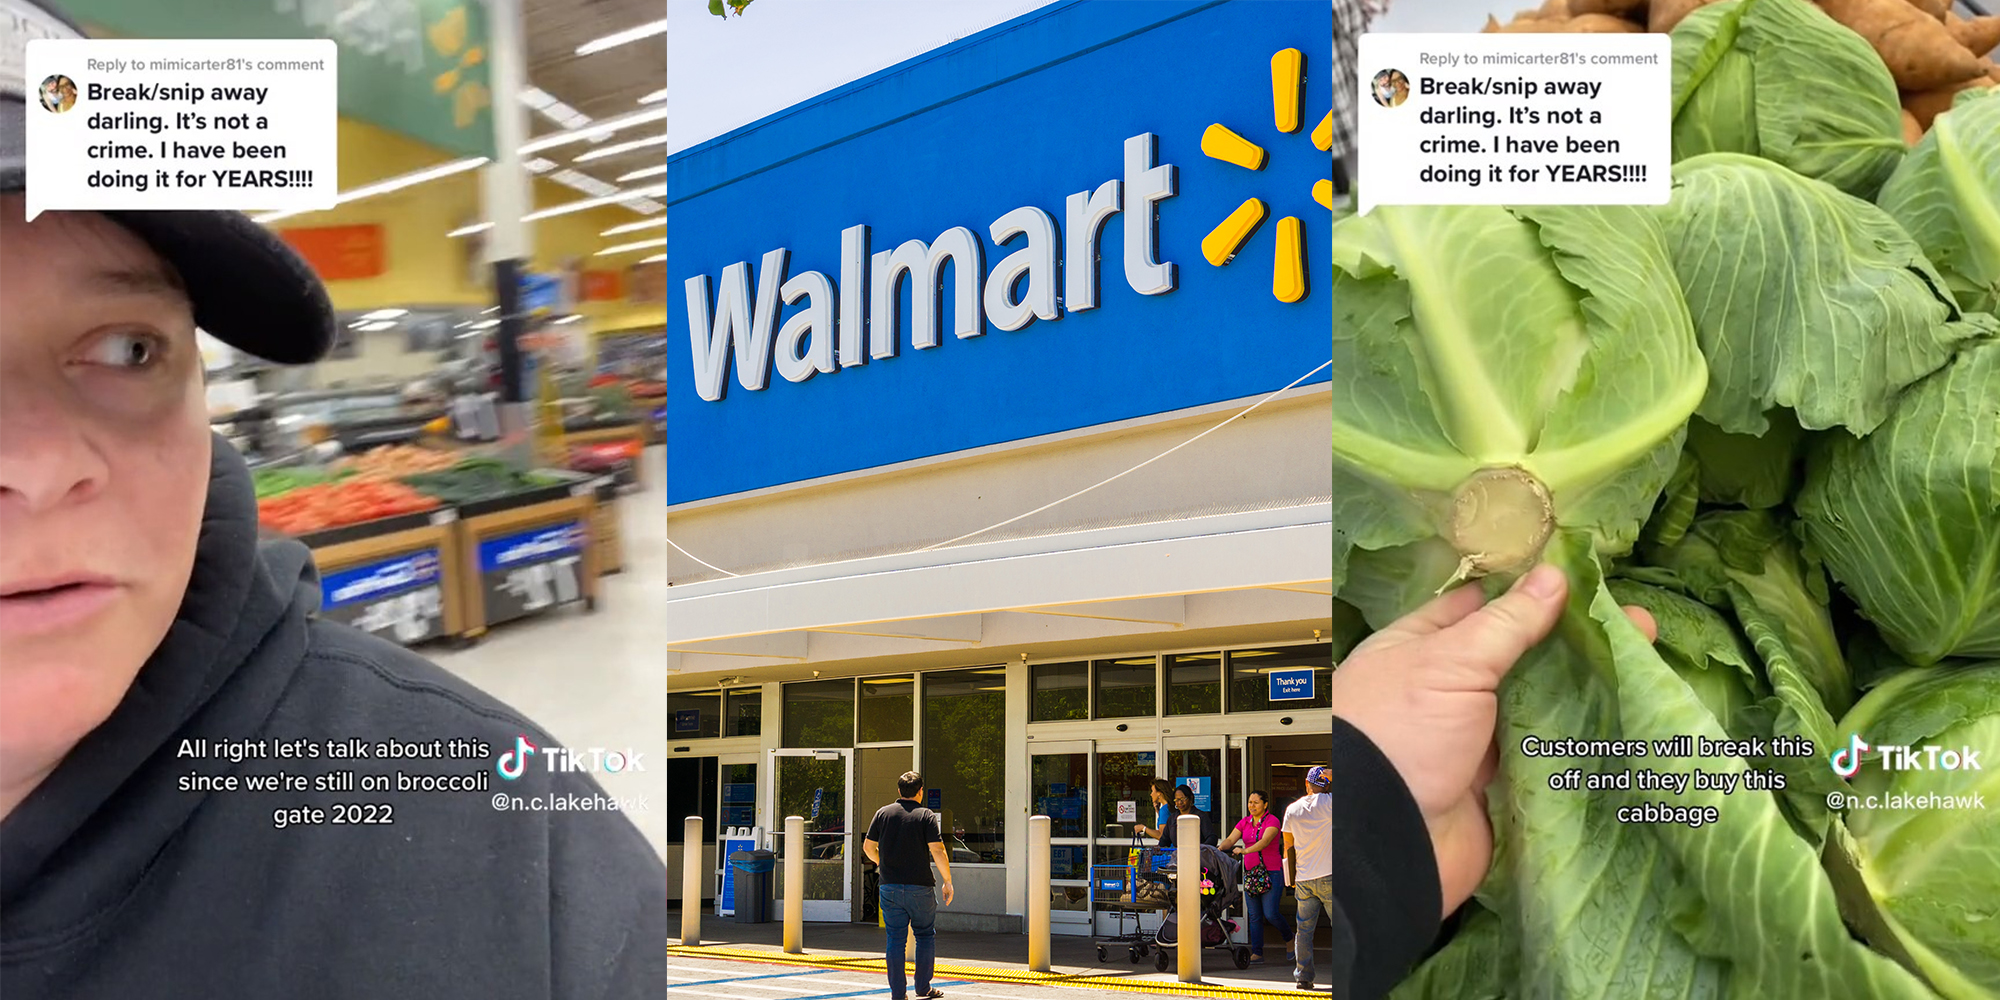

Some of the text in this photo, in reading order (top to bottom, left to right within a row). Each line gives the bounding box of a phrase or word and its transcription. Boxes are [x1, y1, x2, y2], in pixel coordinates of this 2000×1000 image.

[684, 132, 1179, 402] Walmart
[1276, 677, 1307, 687] Thank you
[1053, 849, 1066, 858] EBT
